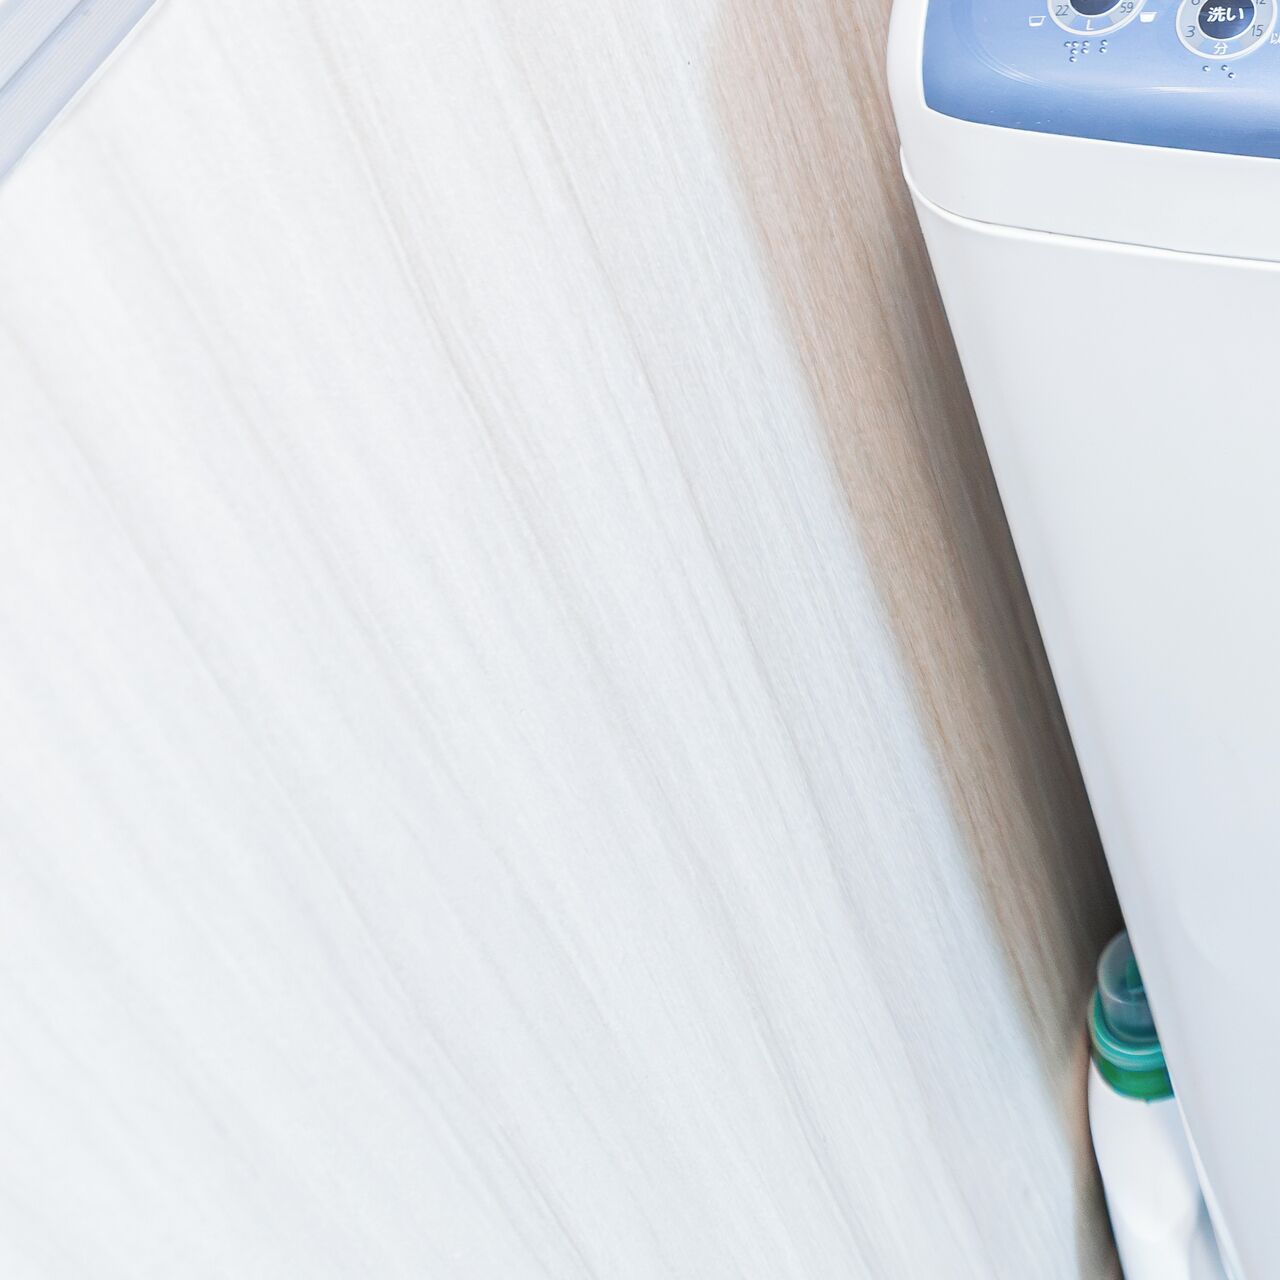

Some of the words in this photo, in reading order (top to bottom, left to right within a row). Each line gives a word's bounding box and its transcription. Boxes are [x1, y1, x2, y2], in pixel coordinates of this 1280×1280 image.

[1055, 5, 1069, 16] 22
[1120, 2, 1135, 14] 59
[1207, 6, 1245, 23] 洗い
[1184, 25, 1196, 38] 3
[1251, 24, 1264, 37] 15
[1213, 42, 1229, 55] 分
